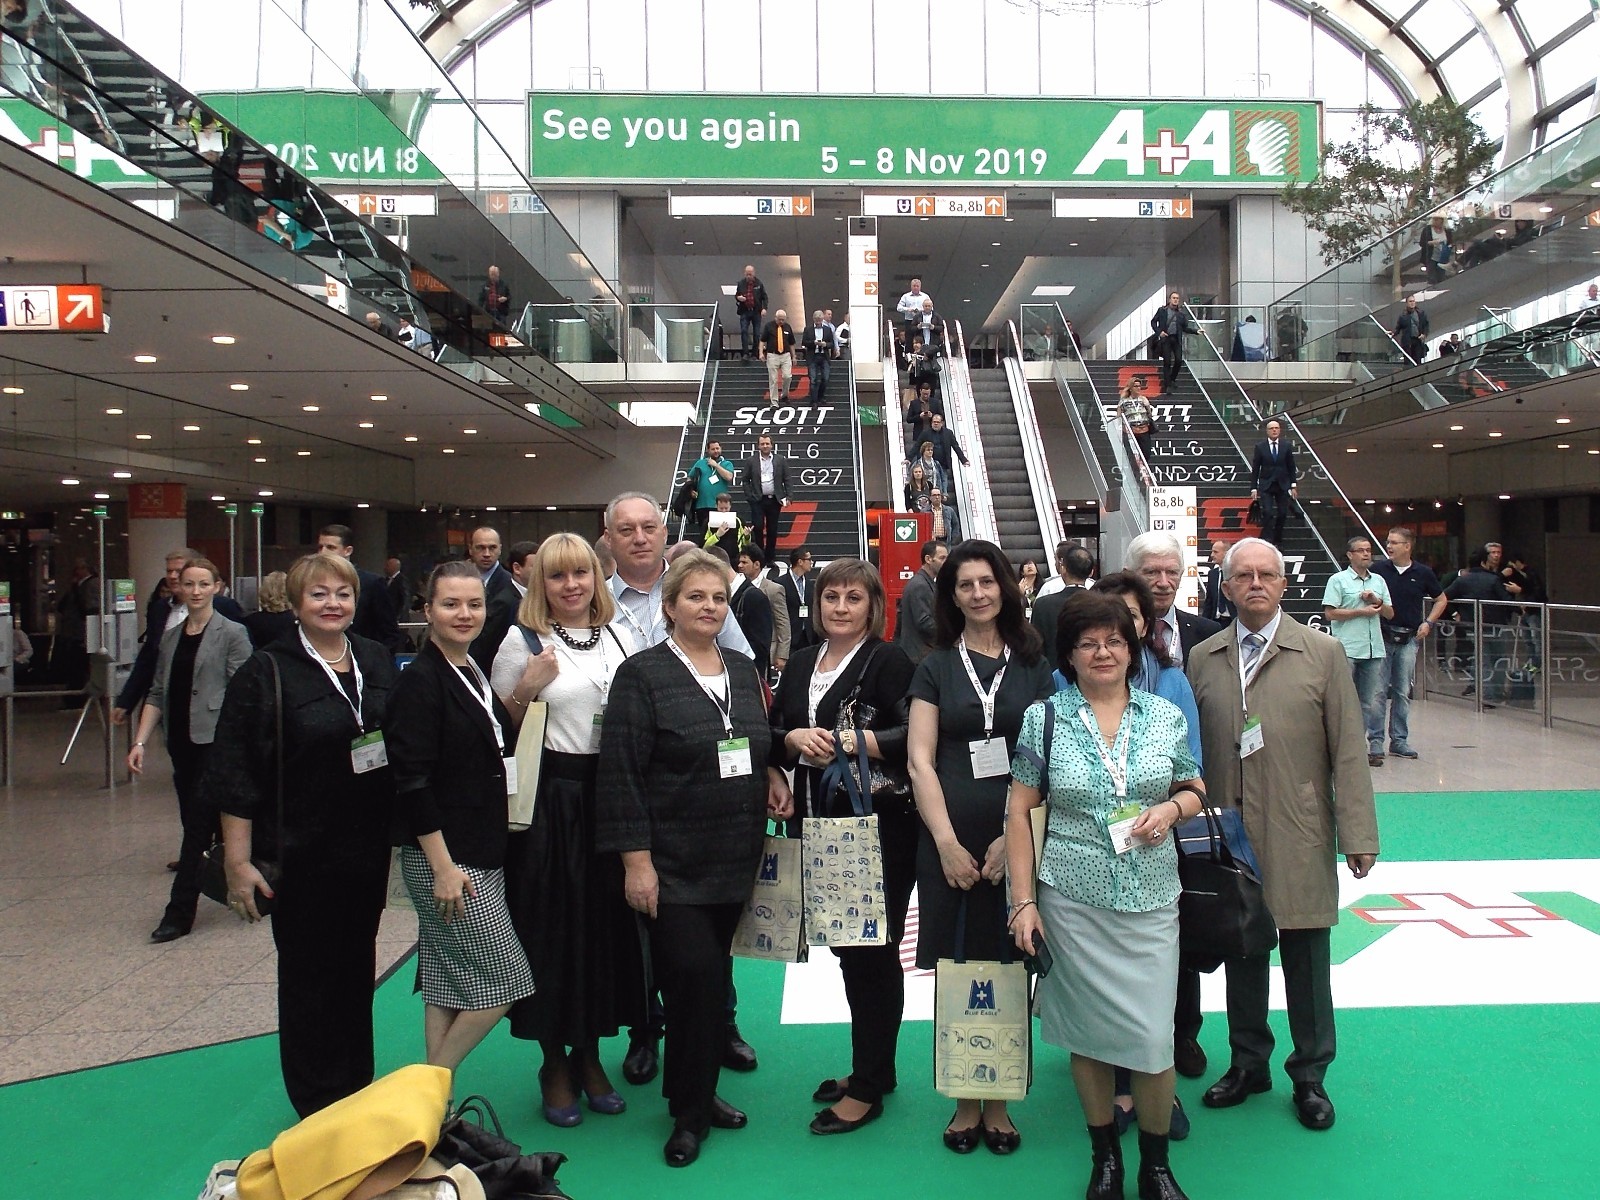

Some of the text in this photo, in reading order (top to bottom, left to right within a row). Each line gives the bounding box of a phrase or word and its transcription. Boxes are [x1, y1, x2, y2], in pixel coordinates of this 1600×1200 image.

[542, 109, 800, 149] See you again
[1072, 109, 1231, 176] A+A
[820, 147, 838, 174] 5
[875, 148, 894, 174] 8
[905, 148, 964, 175] Nov
[974, 148, 1048, 175] 2019
[949, 200, 983, 213] 8a,8b
[732, 406, 834, 425] SCOTT
[727, 427, 820, 435] SAFETY
[806, 443, 820, 459] 6
[1187, 440, 1204, 456] 6
[800, 468, 843, 486] G27
[1195, 465, 1237, 482] G27
[1153, 496, 1184, 508] 8a,8b
